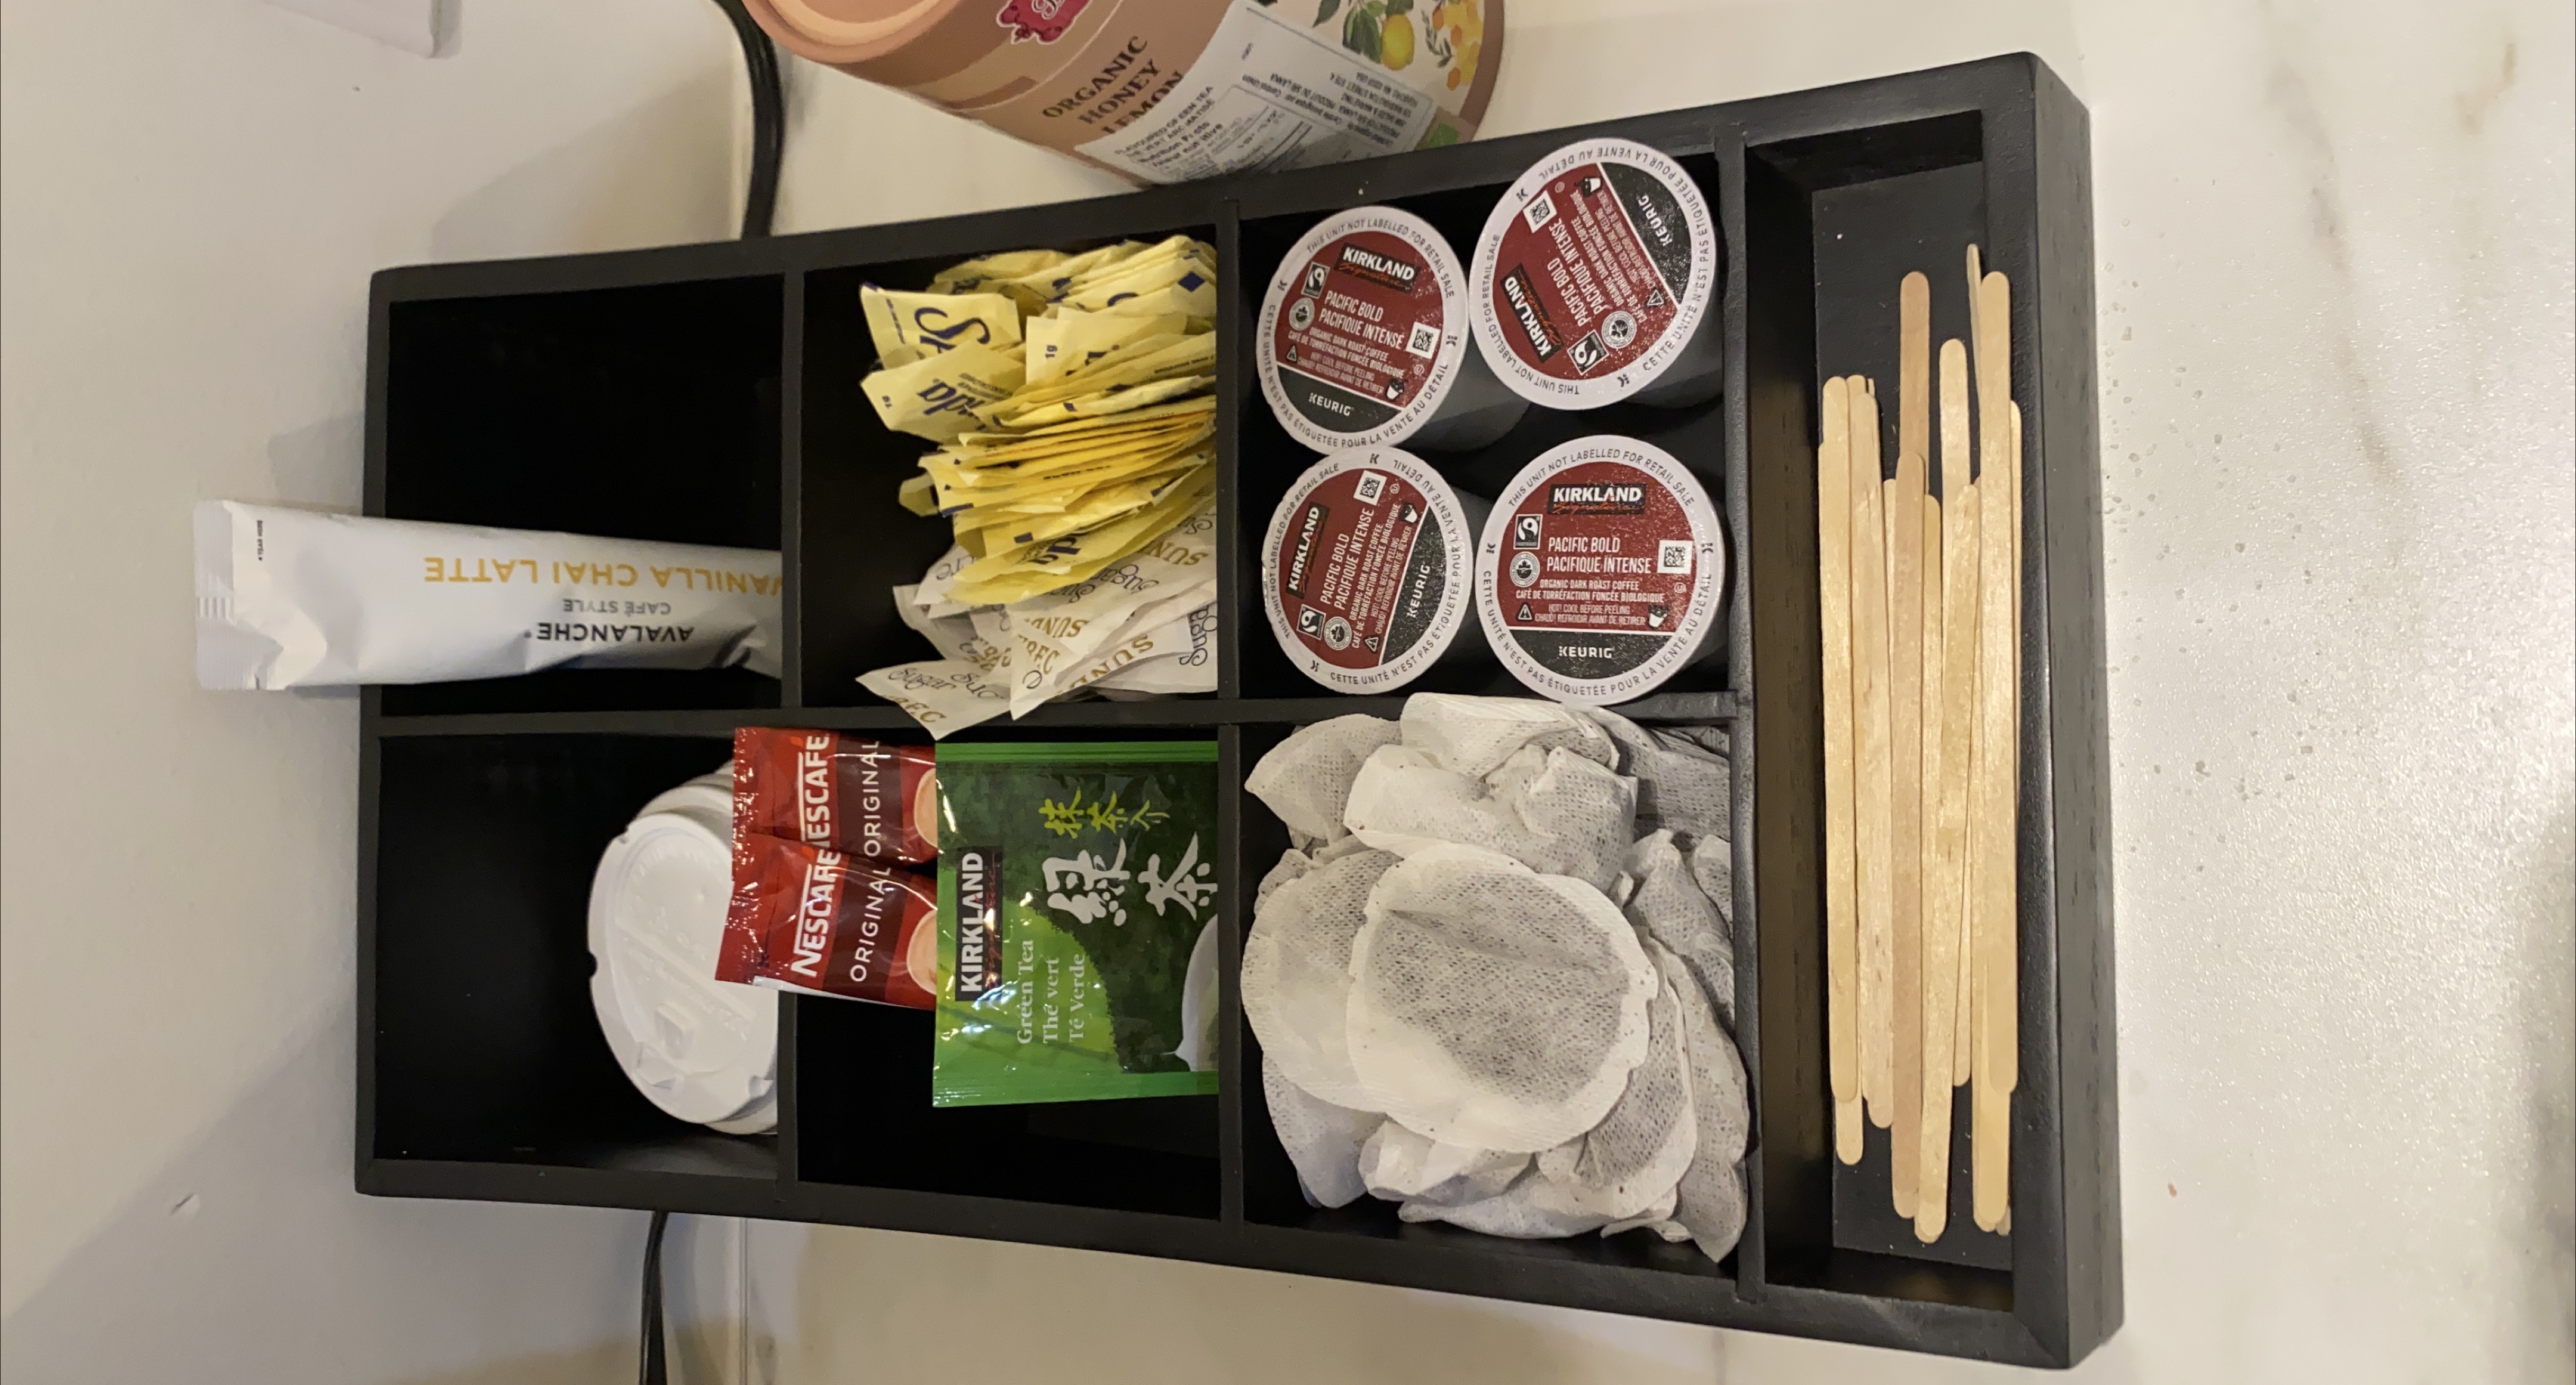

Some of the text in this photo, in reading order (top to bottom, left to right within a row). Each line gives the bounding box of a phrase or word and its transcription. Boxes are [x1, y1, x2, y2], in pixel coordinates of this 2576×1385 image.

[1040, 33, 1150, 120] ORGANIC
[1076, 57, 1161, 126] HONEY
[1577, 147, 1593, 161] AU
[1596, 146, 1633, 159] VENTE
[1633, 149, 1649, 164] LA
[1648, 156, 1677, 182] POUR
[1568, 188, 1596, 228] BIOLOGIQUE
[1635, 193, 1674, 248] KEURIG
[1305, 217, 1456, 299] THIS UNIT NOT LABELLED FOR RETAIL SALE
[1484, 233, 1502, 261] SALE
[1569, 215, 1626, 307] ORGANIC DARK ROAST COFFEE
[1699, 238, 1709, 262] PAS
[1341, 245, 1416, 282] KIRKLAND
[1546, 217, 1610, 316] PACIFIQUE INTENSE
[1480, 262, 1493, 299] RETAIL
[1545, 255, 1593, 328] PACIFIC BOLD
[1691, 265, 1708, 302] N'EST
[1323, 289, 1385, 323] PACIFIC BOLD
[1481, 300, 1494, 324] FOR
[1625, 293, 1639, 307] DE
[1629, 302, 1649, 325] CAFÉ
[1317, 307, 1405, 350] PACIFIQUE INTENSE
[1501, 274, 1554, 356] KIRKLAND
[1485, 322, 1518, 369] LABELLED
[1642, 340, 1677, 376] CETTE
[1513, 363, 1535, 384] NOT
[1532, 375, 1556, 392] UNIT
[1555, 382, 1580, 395] THIS
[1308, 391, 1354, 417] KEURIG
[1317, 460, 1340, 480] SALE
[1507, 484, 1528, 508] THIS
[1524, 466, 1549, 489] UNIT
[1546, 454, 1569, 473] NOT
[1569, 447, 1622, 463] LABELLED
[1621, 449, 1644, 465] FOR
[1643, 456, 1677, 486] RETAIL
[1671, 478, 1696, 508] SALE
[1292, 474, 1319, 503] RETAIL
[1422, 477, 1436, 494] AU
[1553, 486, 1643, 503] KIRKLAND
[1281, 499, 1298, 521] FOR
[1432, 491, 1454, 526] VENTE
[1379, 502, 1401, 545] BIOLOGIQUE
[1268, 520, 1287, 569] LABELLED
[1287, 505, 1321, 591] KIRKLAND
[1332, 506, 1375, 611] PACIFIQUE INTENSE
[1370, 543, 1387, 572] FONCÉE
[1547, 536, 1621, 554] PACIFIC BOLD
[422, 555, 539, 586] LATTE
[550, 560, 639, 588] CHAI
[1318, 531, 1351, 605] PACIFIC BOLD
[1348, 521, 1384, 622] ORGANIC DARK ROAST COFFEE
[1546, 555, 1652, 574] PACIFIQUE INTENSE
[1268, 571, 1277, 593] NOT
[1405, 562, 1431, 619] KEURIG
[1482, 570, 1494, 607] CETTE
[1515, 588, 1664, 603] CAFÉ DE TORRÉFACTION FONCÉE BIOLOGIQUE
[1539, 578, 1640, 591] ORGANIC DARK ROAST COFFEE
[1690, 573, 1713, 617] DÉTAIL
[561, 598, 671, 617] CAFÉ STYLE
[1270, 593, 1283, 618] UNIT
[1276, 616, 1292, 639] THIS
[1349, 629, 1363, 649] CAFÉ
[1355, 619, 1366, 631] DE
[1487, 607, 1508, 642] UNITÉ
[1683, 617, 1700, 637] AU
[1416, 637, 1435, 660] PAS
[1501, 639, 1528, 670] N'EST
[1558, 645, 1613, 659] KEURIG
[1655, 635, 1689, 672] VENTE
[887, 664, 957, 691] Sugar
[1329, 671, 1359, 685] CETTE
[1390, 654, 1419, 678] N'EST
[1525, 664, 1547, 684] PAS
[1641, 664, 1658, 681] LA
[1545, 675, 1607, 696] ÉTIQUETÉE
[1609, 673, 1642, 694] POUR
[861, 739, 883, 857] ORIGINAL
[849, 866, 891, 982] ORIGINAL
[960, 851, 984, 993] KIRKLAND
[1015, 939, 1035, 1044] Green Tea
[1041, 956, 1060, 1044] Thé vert
[1067, 953, 1085, 1043] Té Verde
